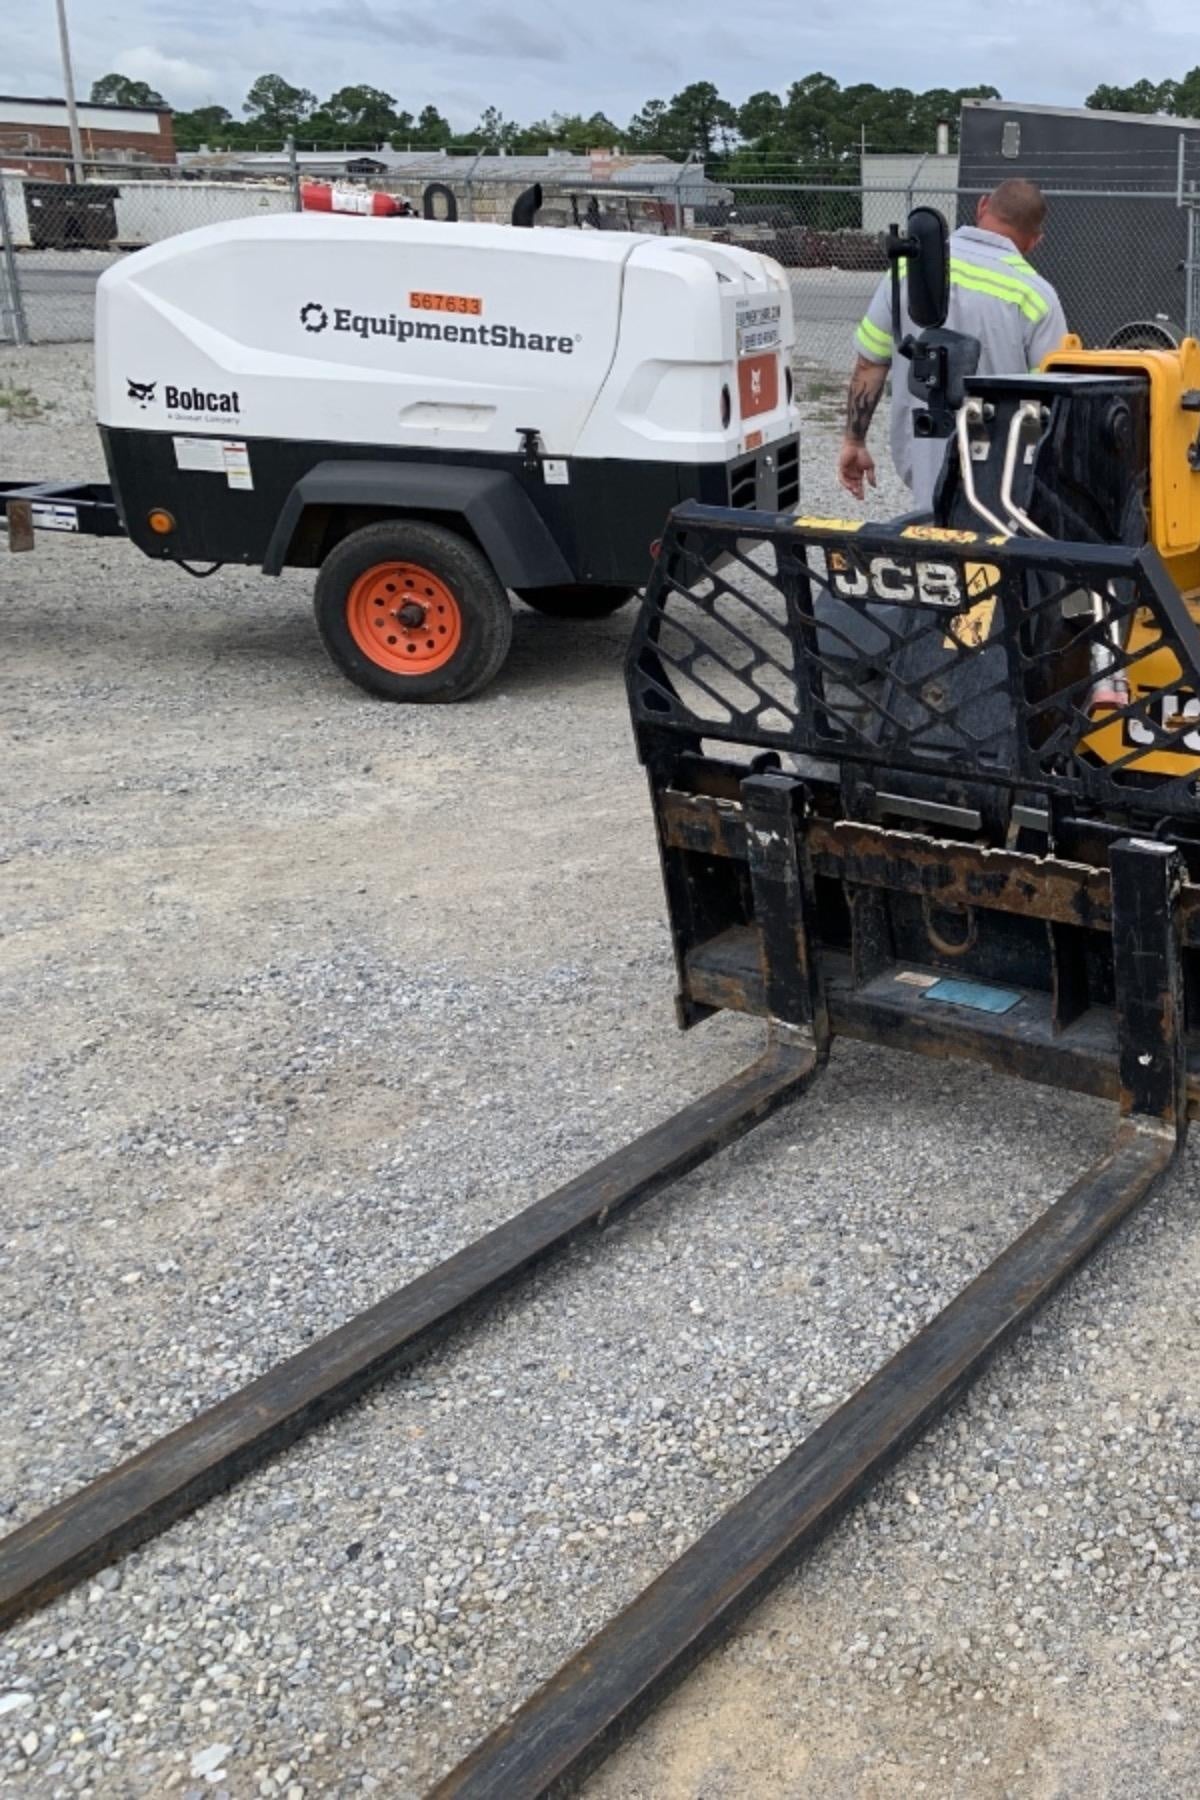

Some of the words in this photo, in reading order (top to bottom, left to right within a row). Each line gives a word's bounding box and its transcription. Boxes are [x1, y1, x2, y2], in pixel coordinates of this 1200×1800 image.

[411, 292, 481, 315] 567633
[333, 307, 574, 354] EquipmentShare
[165, 385, 240, 413] Bobcat
[833, 555, 962, 608] JCB
